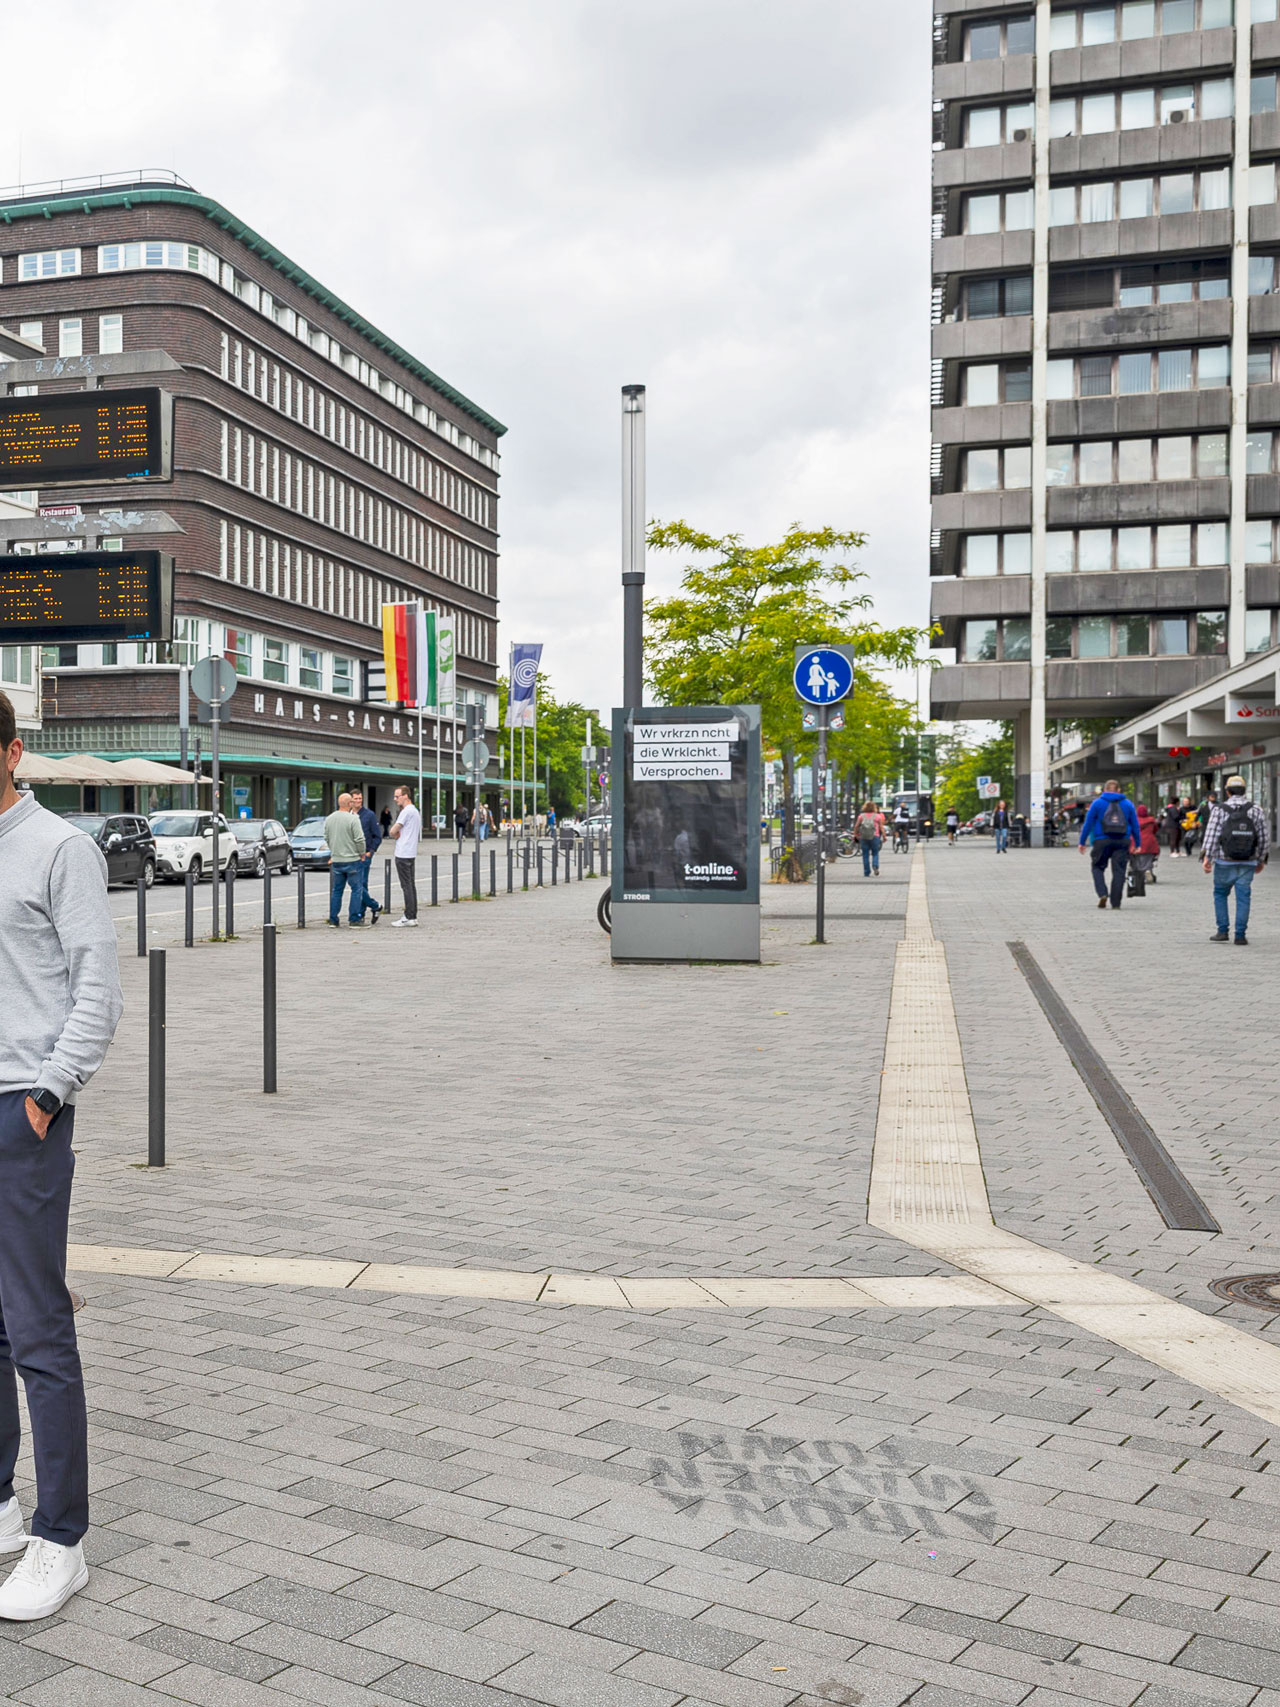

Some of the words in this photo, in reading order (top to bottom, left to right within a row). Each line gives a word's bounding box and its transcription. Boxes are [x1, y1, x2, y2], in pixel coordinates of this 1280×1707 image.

[39, 507, 77, 517] Restaurant
[640, 729, 657, 738] Wr
[661, 728, 698, 738] vrkrzn
[702, 728, 730, 738] ncht
[640, 748, 658, 757] die
[662, 746, 721, 757] Wrklchkt.
[640, 767, 723, 778] Versprochen.
[684, 863, 738, 875] t-online.
